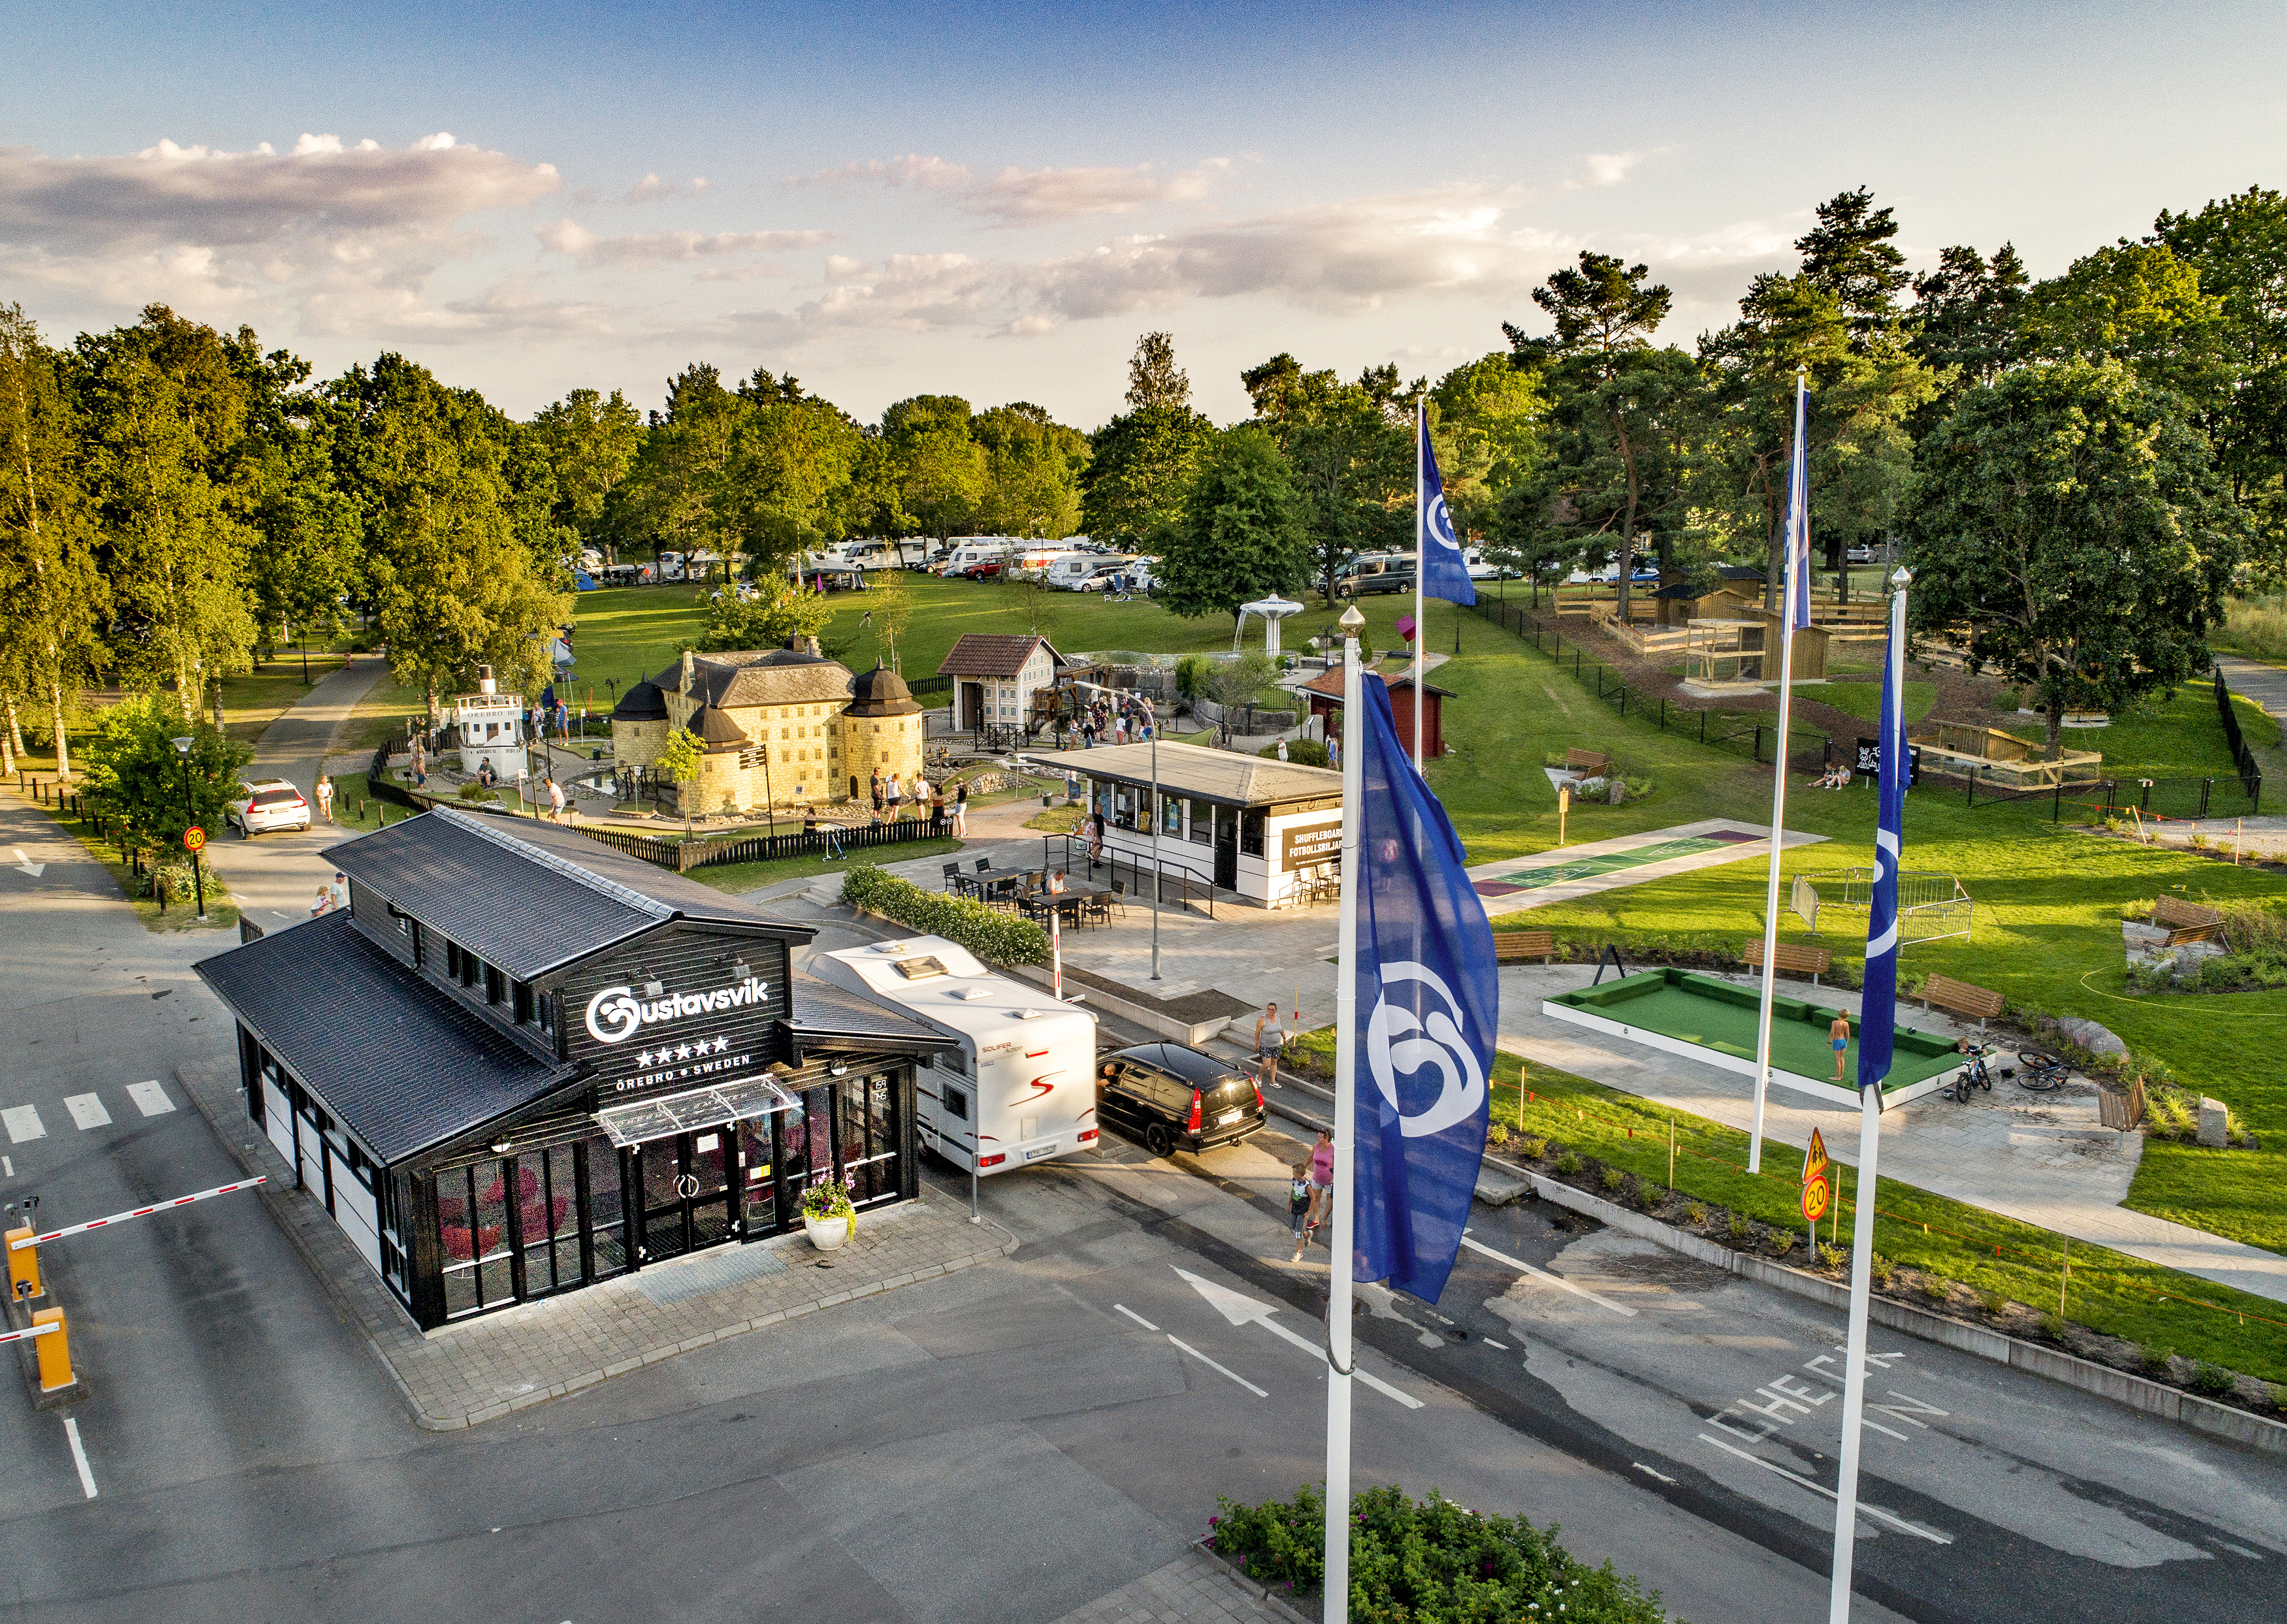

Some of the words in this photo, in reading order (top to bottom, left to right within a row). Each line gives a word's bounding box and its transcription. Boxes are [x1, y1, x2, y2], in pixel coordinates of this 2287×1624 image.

[189, 832, 202, 845] 20
[1290, 840, 1342, 857] FOTBOLLSBILJAR
[585, 977, 769, 1043] Gustavsvik
[982, 1042, 1012, 1053] SOLIFER
[616, 1070, 674, 1091] ÖREBRO
[693, 1054, 750, 1075] SWEDEN
[1808, 1184, 1825, 1212] 20
[1704, 1346, 1906, 1444] CHECK
[1860, 1390, 1950, 1442] IN
